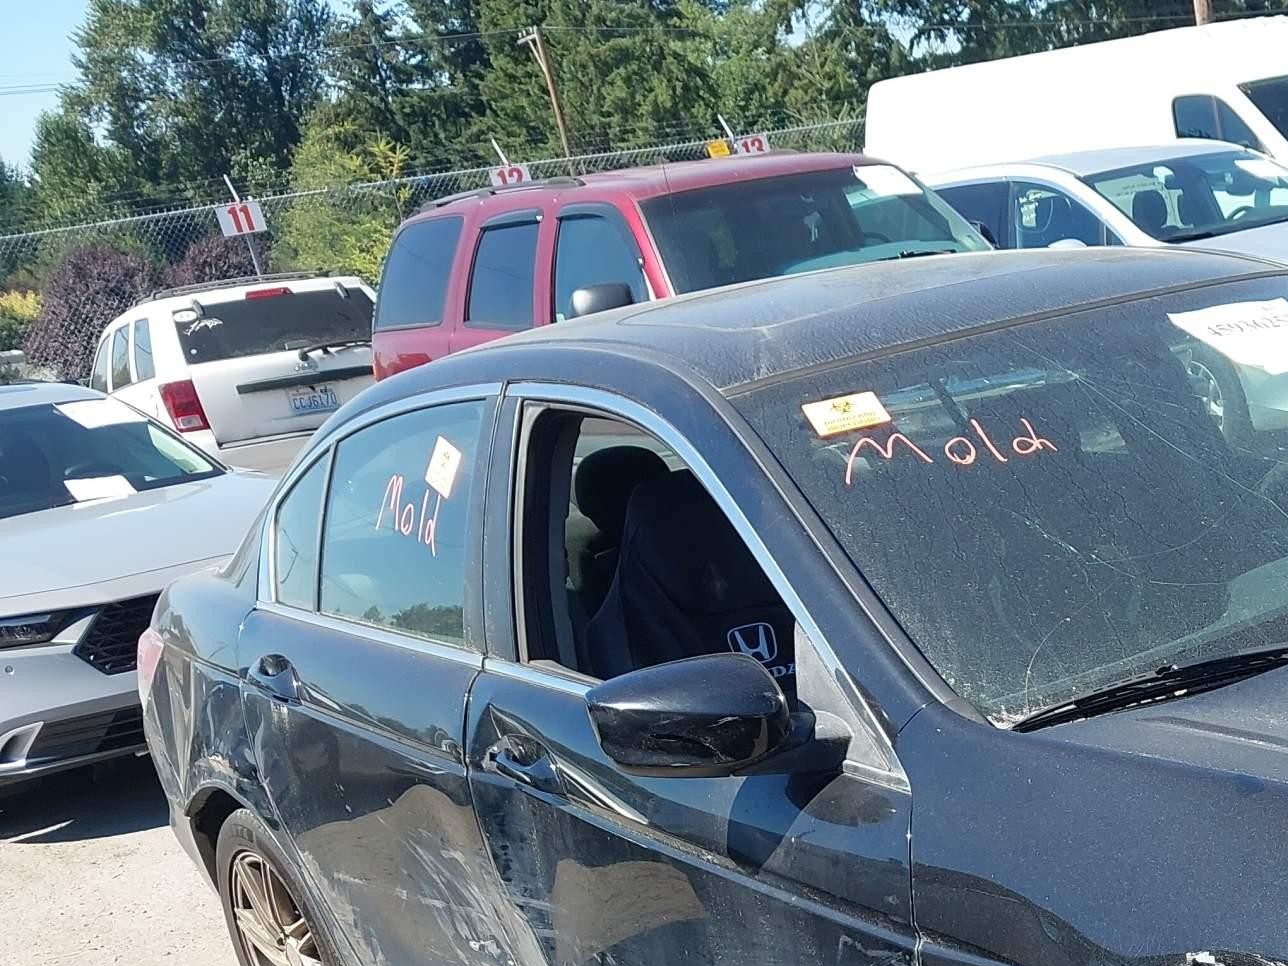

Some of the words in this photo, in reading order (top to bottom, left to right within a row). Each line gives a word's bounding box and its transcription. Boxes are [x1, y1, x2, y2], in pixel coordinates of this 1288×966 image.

[227, 204, 256, 233] 11
[845, 418, 1058, 485] Mold
[375, 474, 442, 558] Mold
